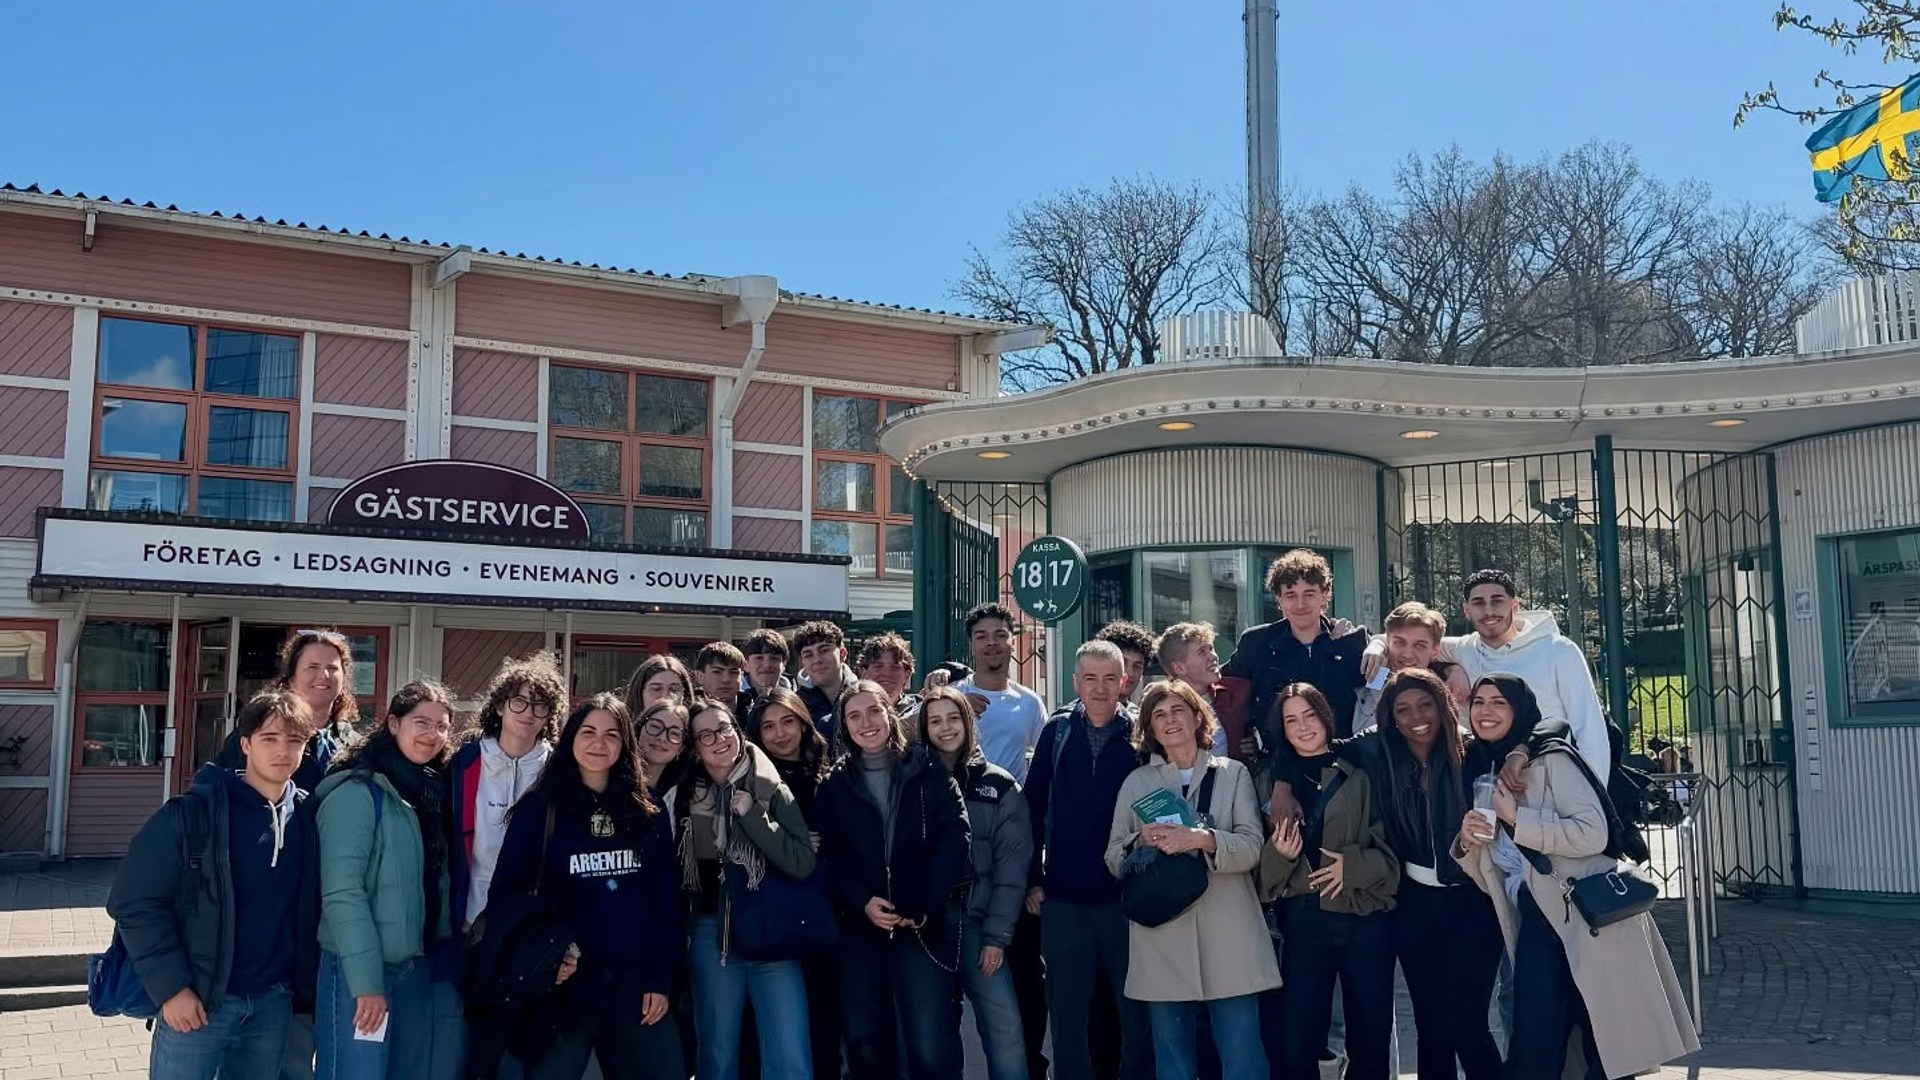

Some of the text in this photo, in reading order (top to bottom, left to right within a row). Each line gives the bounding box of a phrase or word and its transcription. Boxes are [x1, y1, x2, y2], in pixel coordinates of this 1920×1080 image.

[354, 487, 570, 529] GÄSTSERVICE
[1032, 543, 1061, 553] KASSA
[143, 539, 775, 595] FÖRETAG LEDSAGNING EVENEMANG SOUVENIRER
[1017, 559, 1075, 589] 18 17
[569, 849, 642, 875] ARGENTIN
